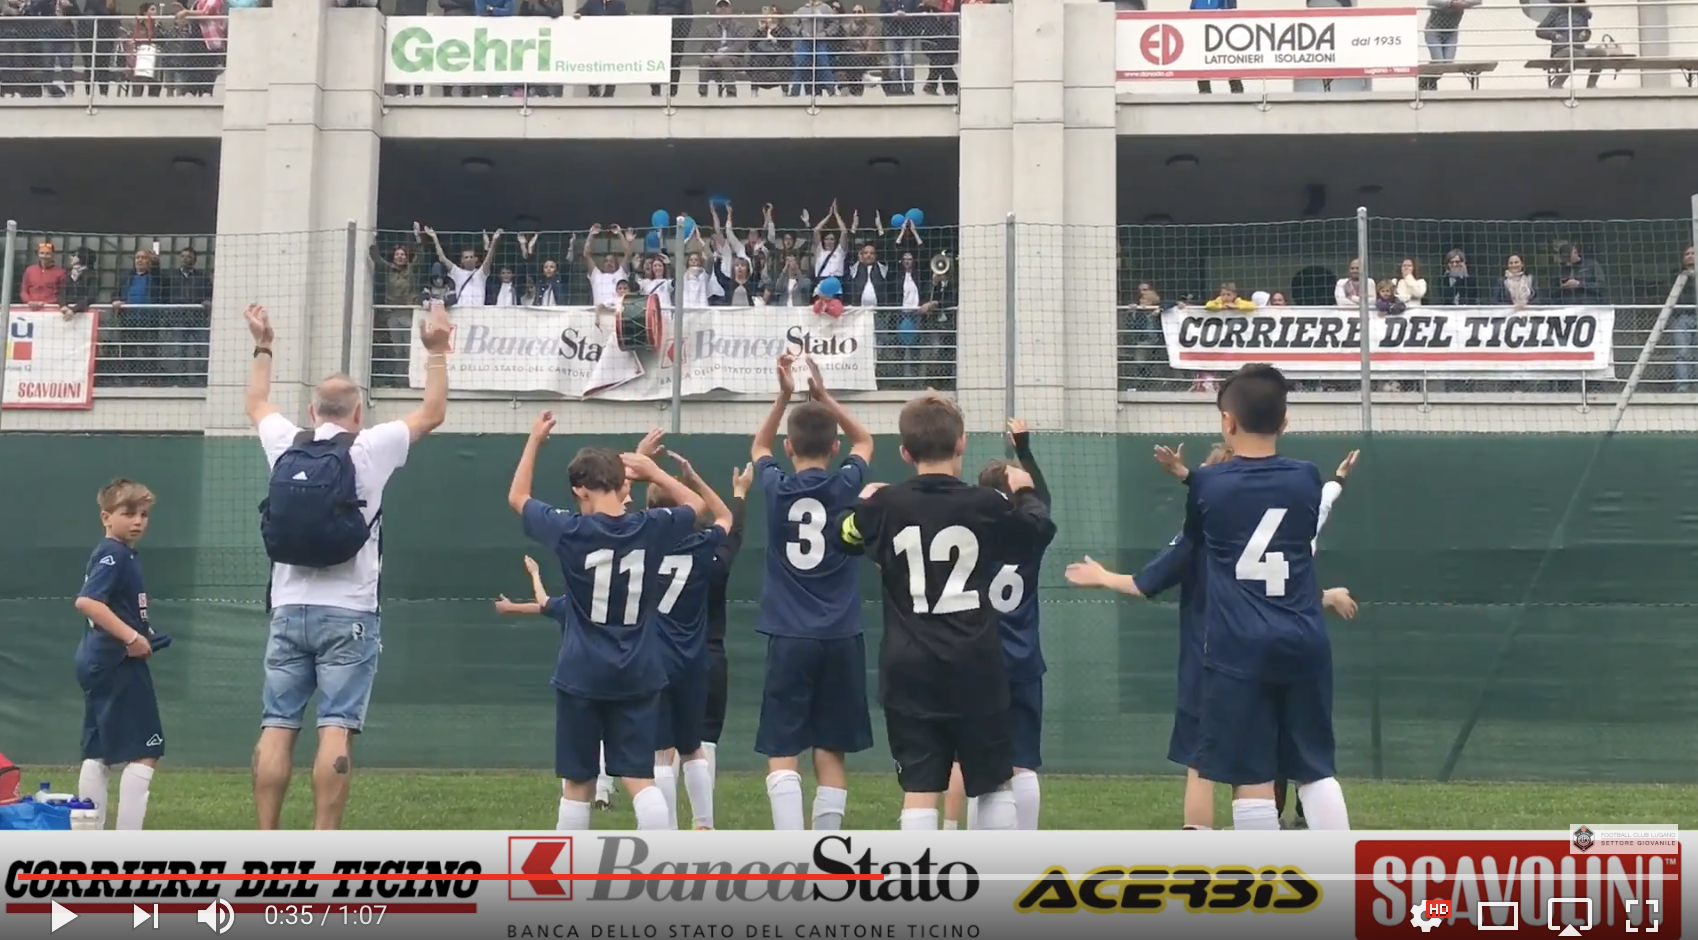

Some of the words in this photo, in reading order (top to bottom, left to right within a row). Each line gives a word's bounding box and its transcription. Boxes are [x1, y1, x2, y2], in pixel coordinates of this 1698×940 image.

[391, 27, 551, 73] Gehri
[555, 60, 642, 73] Rivestimenti
[646, 60, 666, 72] SA
[1140, 24, 1184, 66] ED
[1204, 22, 1335, 52] DONADA
[1351, 38, 1371, 47] dal
[1374, 36, 1402, 46] 1935
[1204, 54, 1264, 65] LATTONIERI
[1275, 53, 1336, 64] ISOLAZIONI
[463, 324, 606, 362] BancaSta
[693, 325, 858, 361] BancaStato
[1379, 316, 1453, 348] DEL
[1464, 315, 1597, 348] TICINO
[17, 382, 82, 398] SCAVOLINI
[786, 497, 827, 570] 3
[1235, 507, 1289, 597] 4
[584, 548, 645, 625] 11
[657, 554, 694, 614] 7
[892, 525, 981, 614] 12
[988, 564, 1025, 613] 6
